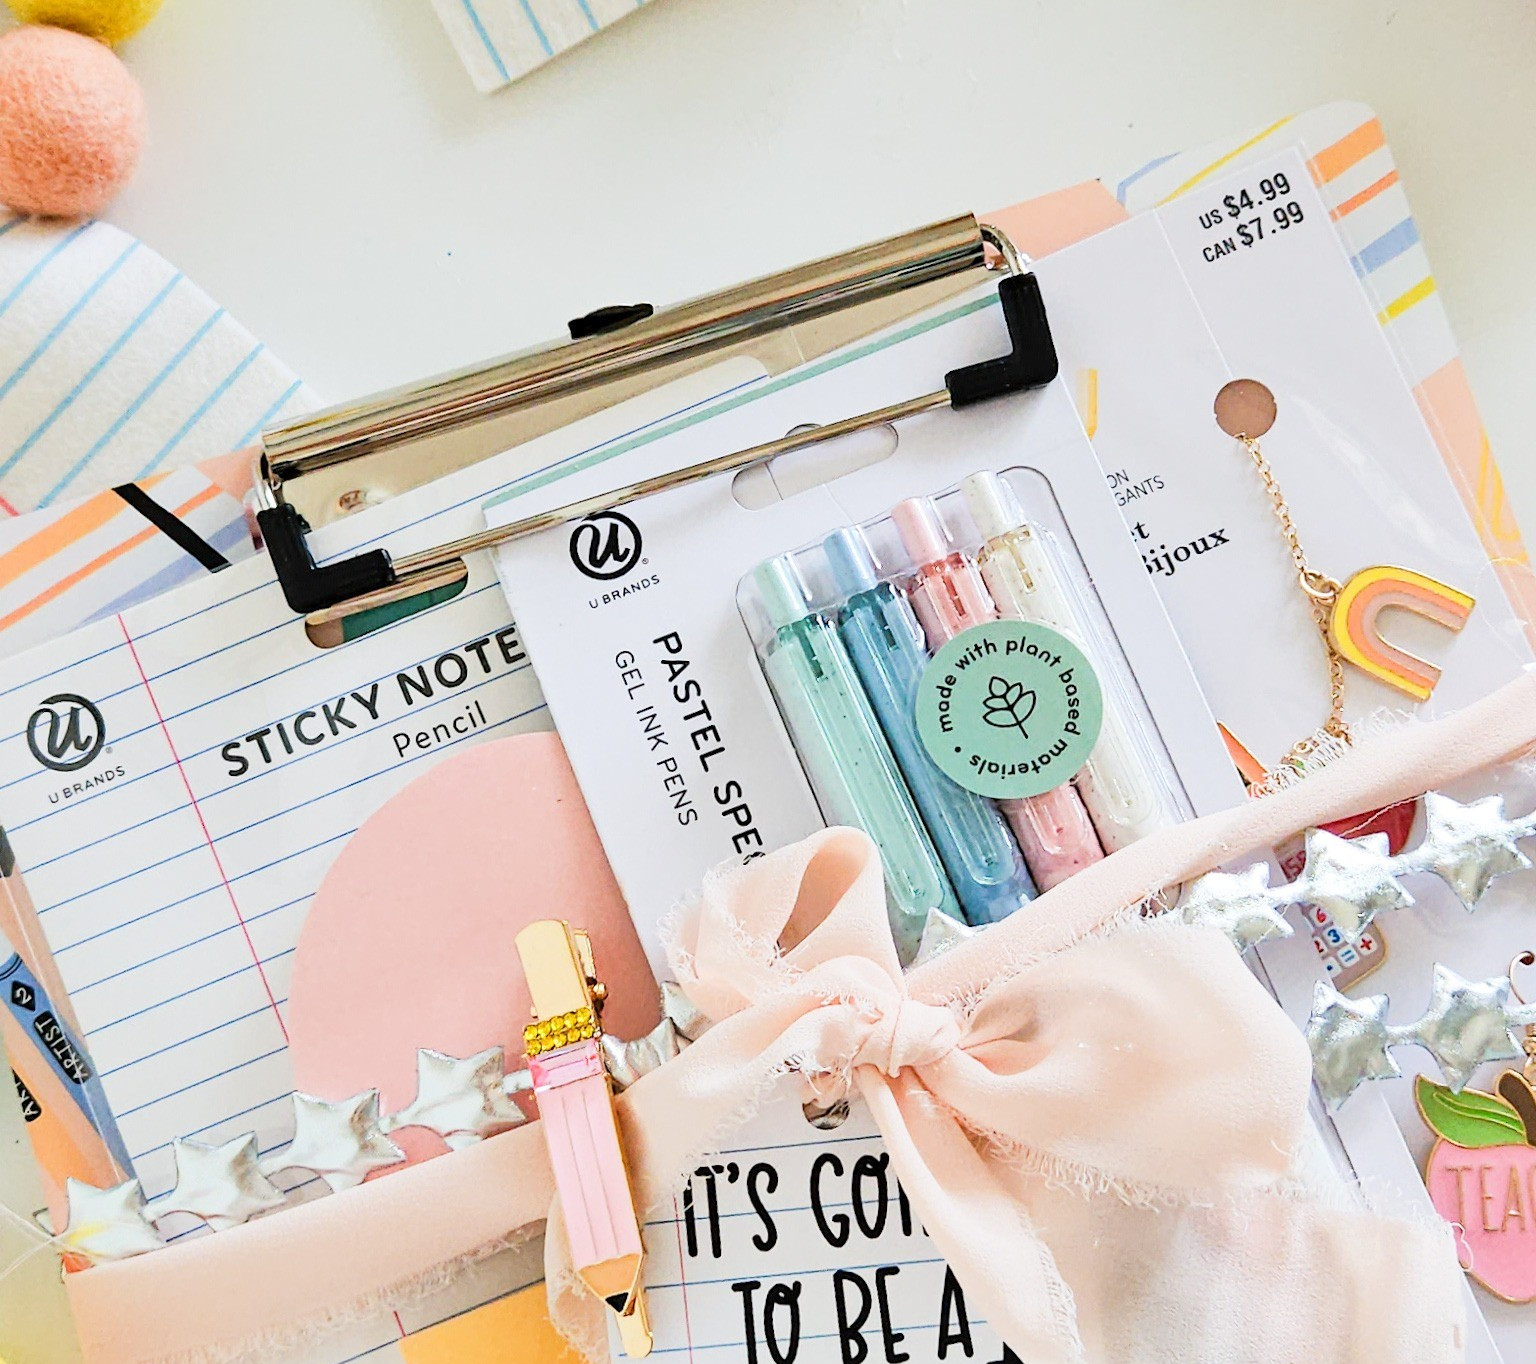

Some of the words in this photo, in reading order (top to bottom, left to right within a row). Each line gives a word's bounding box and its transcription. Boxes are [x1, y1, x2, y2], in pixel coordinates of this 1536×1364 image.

[1199, 209, 1223, 229] US
[1223, 172, 1290, 219] $4.99
[1203, 237, 1237, 262] CAN
[1236, 201, 1304, 247] $7.99
[602, 574, 660, 605] BRANDS
[955, 638, 998, 670] with
[1006, 636, 1062, 667] plant
[221, 683, 380, 777] STICKY
[396, 627, 527, 706] NOTE
[392, 700, 488, 758] Pencil
[653, 631, 726, 772] PASTEL
[936, 674, 957, 733] made
[1059, 668, 1081, 736] based
[615, 650, 645, 700] GEL
[636, 705, 668, 751] INK
[657, 756, 698, 826] PENS
[969, 738, 1068, 779] materials
[63, 766, 126, 799] BRANDS
[1316, 908, 1327, 923] 6
[1328, 929, 1340, 943] 3
[16, 987, 32, 1004] 2
[35, 1017, 89, 1080] ARTIST
[683, 1162, 778, 1258] IT'S
[1444, 1165, 1536, 1232] TEA
[938, 1263, 974, 1360] A
